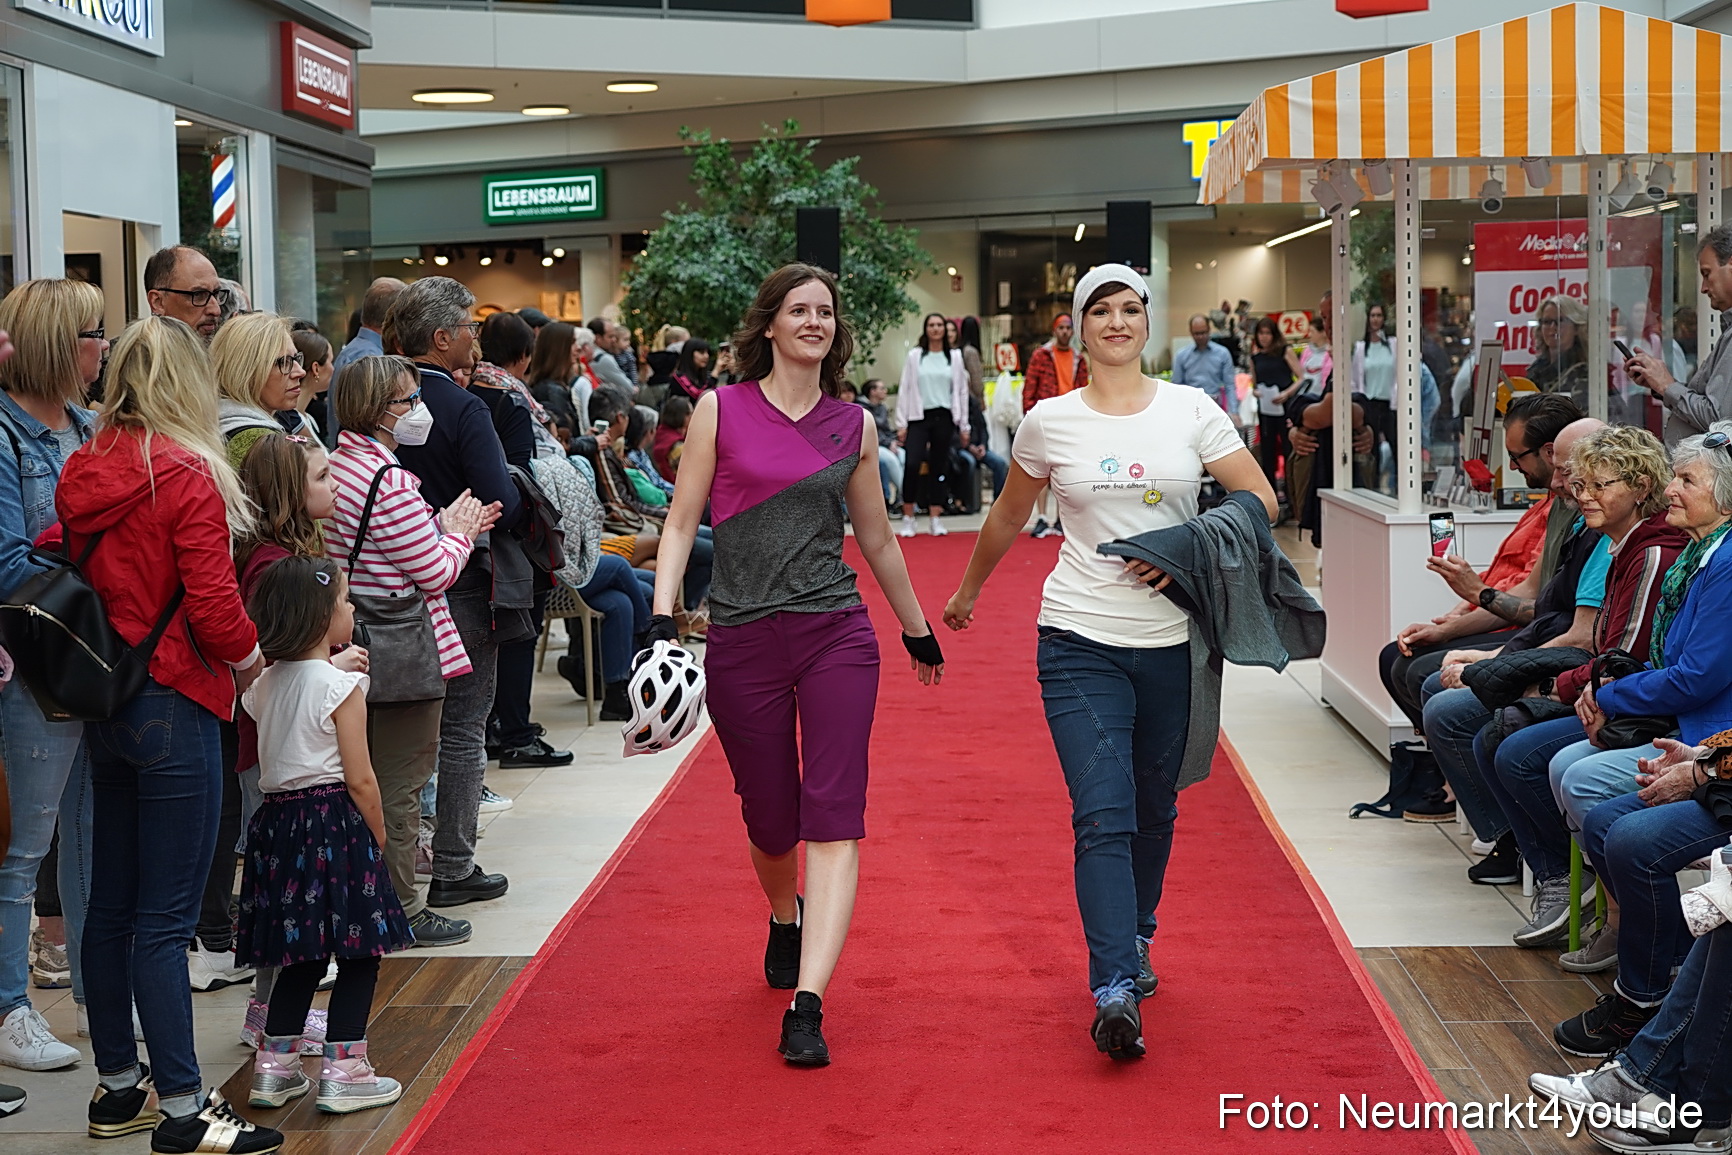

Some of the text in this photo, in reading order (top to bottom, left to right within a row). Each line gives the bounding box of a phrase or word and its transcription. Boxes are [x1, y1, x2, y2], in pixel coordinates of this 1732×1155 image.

[298, 55, 348, 99] LEBENSRAUM
[494, 185, 590, 207] LEBENSRAUM
[1283, 317, 1304, 335] 2€
[8, 1034, 24, 1049] FILA
